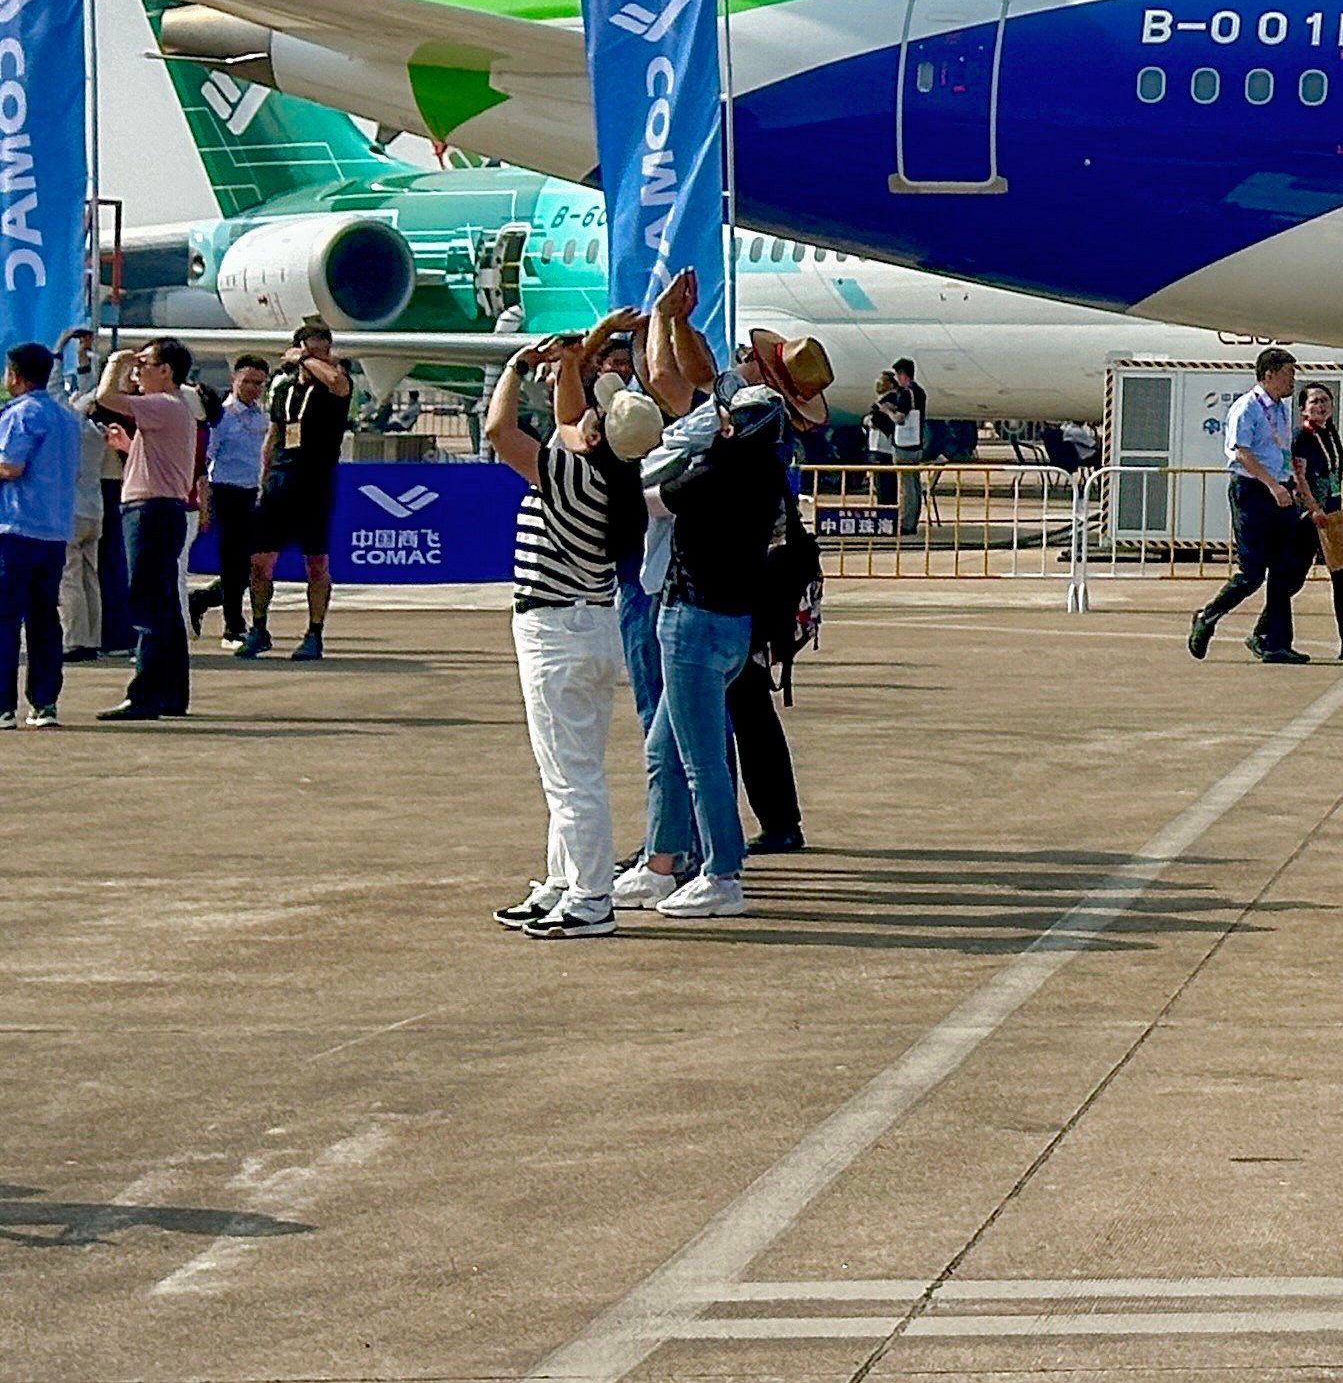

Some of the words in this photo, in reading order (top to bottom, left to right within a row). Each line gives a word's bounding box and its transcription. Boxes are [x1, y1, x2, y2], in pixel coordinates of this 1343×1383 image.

[820, 517, 894, 535] 中国珠海
[351, 529, 442, 548] 中国商飞
[351, 549, 442, 565] COMAC
